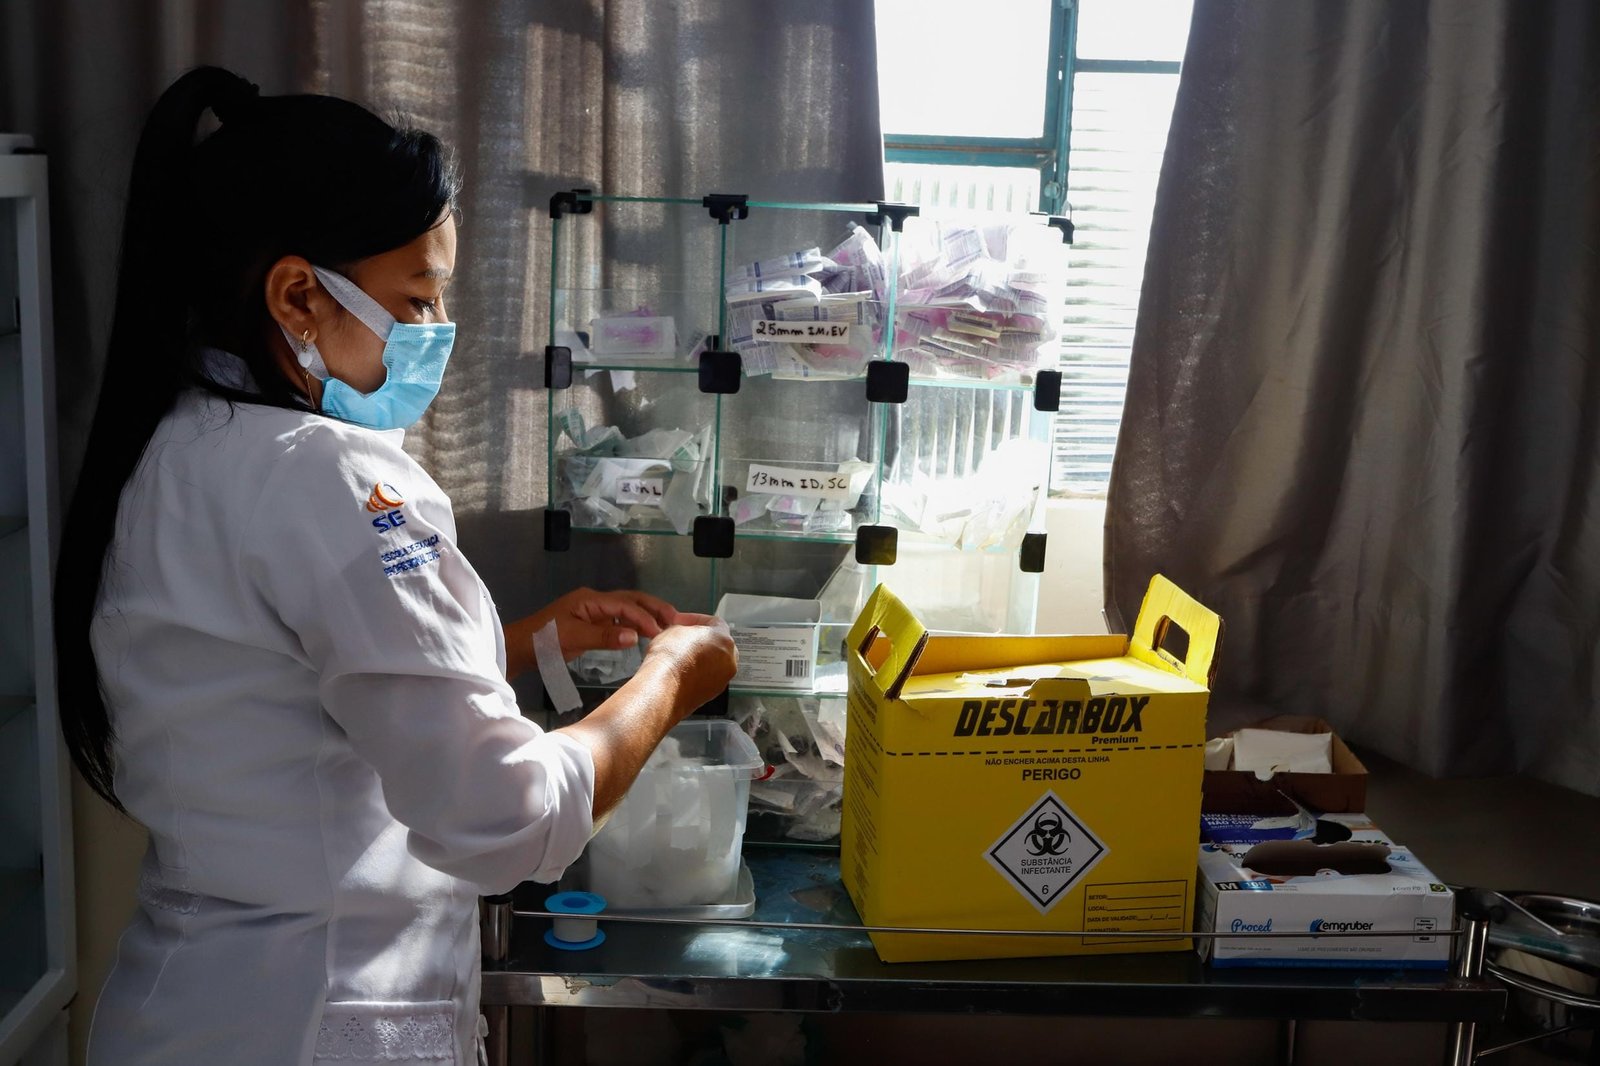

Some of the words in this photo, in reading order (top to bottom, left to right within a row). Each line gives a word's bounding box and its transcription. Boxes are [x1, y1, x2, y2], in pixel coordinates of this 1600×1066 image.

[756, 321, 803, 336] 25mm
[752, 471, 794, 488] 13mm
[953, 696, 1151, 737] DESCARBOX
[1091, 736, 1139, 745] Premium
[985, 758, 1002, 766] NÃO
[1036, 757, 1060, 765] ACIMA
[1022, 768, 1081, 781] PERIGO
[1021, 857, 1072, 866] SUBSTÂNCIA
[1021, 866, 1071, 875] INFECTANTE
[1041, 884, 1049, 895] 6
[1218, 882, 1239, 890] M
[1231, 918, 1273, 933] Proced
